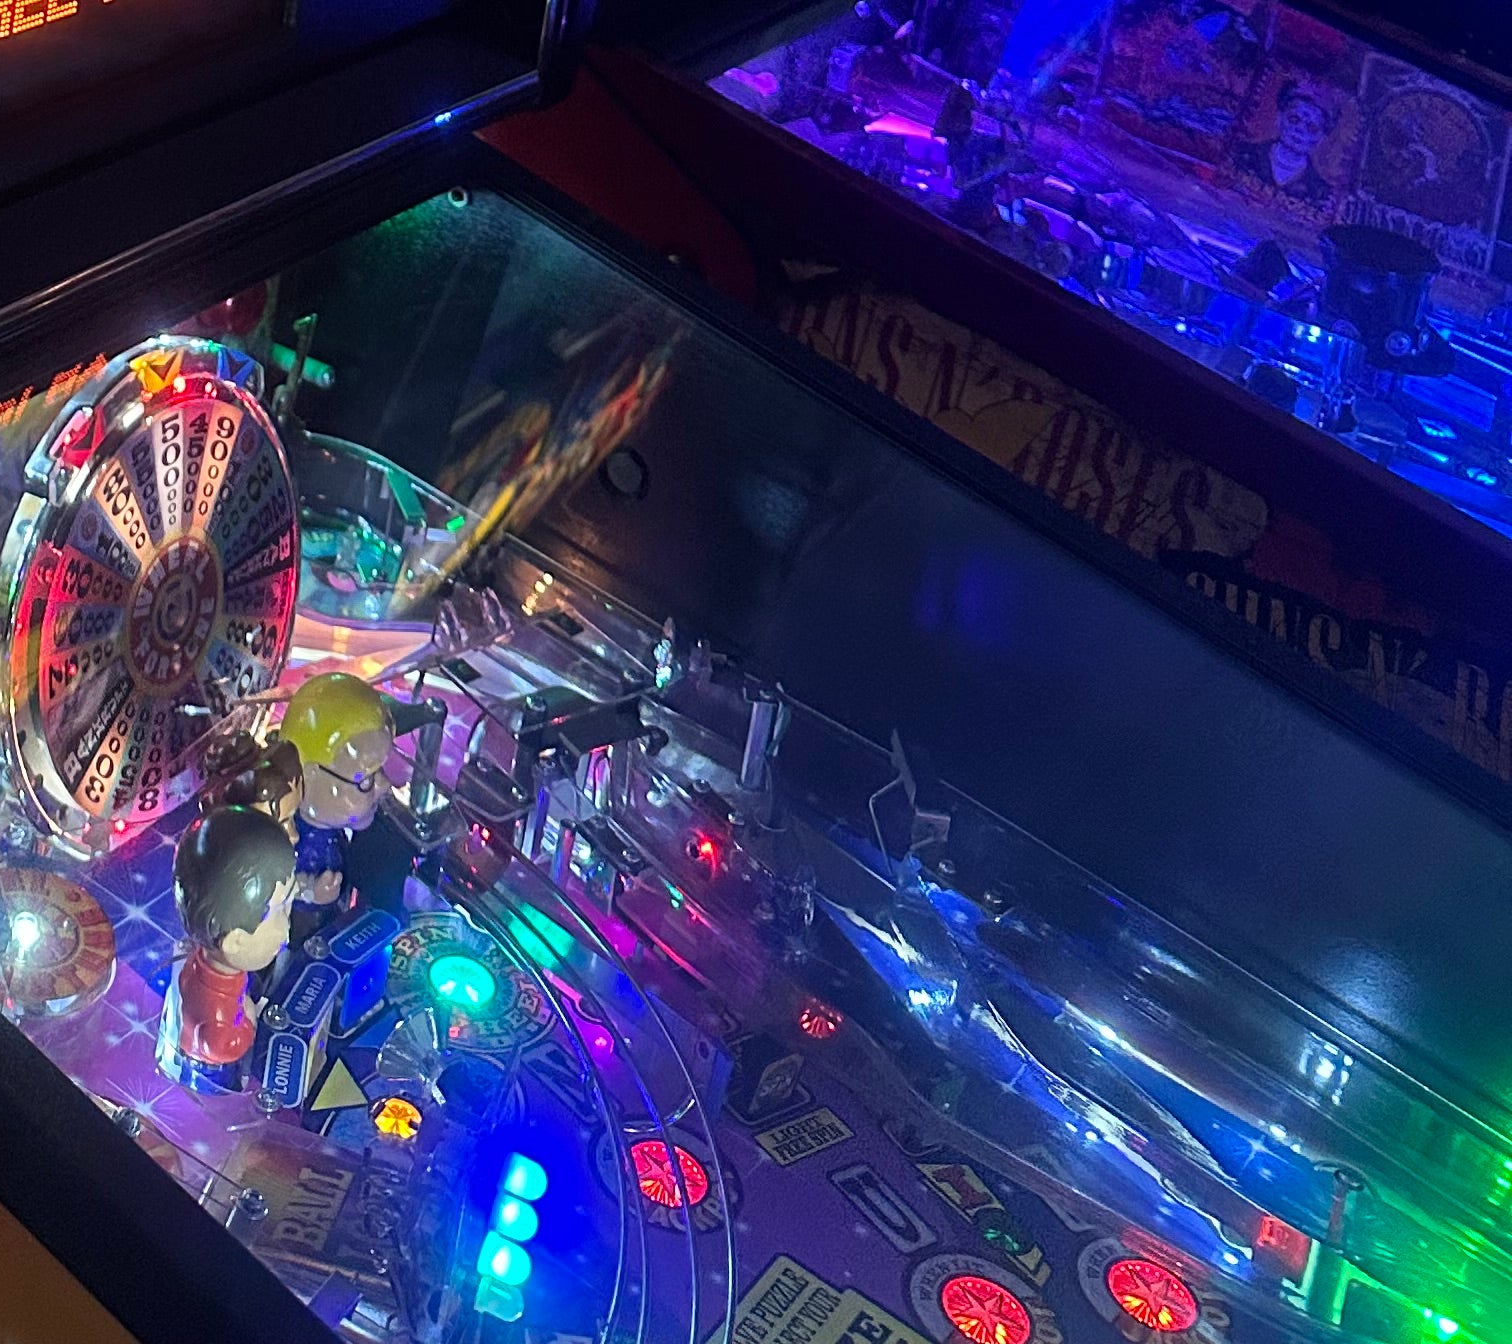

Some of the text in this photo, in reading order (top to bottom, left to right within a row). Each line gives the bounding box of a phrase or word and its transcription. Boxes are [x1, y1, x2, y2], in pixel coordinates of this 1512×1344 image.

[197, 415, 236, 517] 90000
[344, 921, 381, 952] KEITH
[293, 976, 327, 1016] MARIA
[274, 1042, 296, 1095] LONNIE
[767, 1115, 822, 1149] LIGHT
[750, 1267, 810, 1328] PUZZLE
[797, 1286, 842, 1328] YOUR
